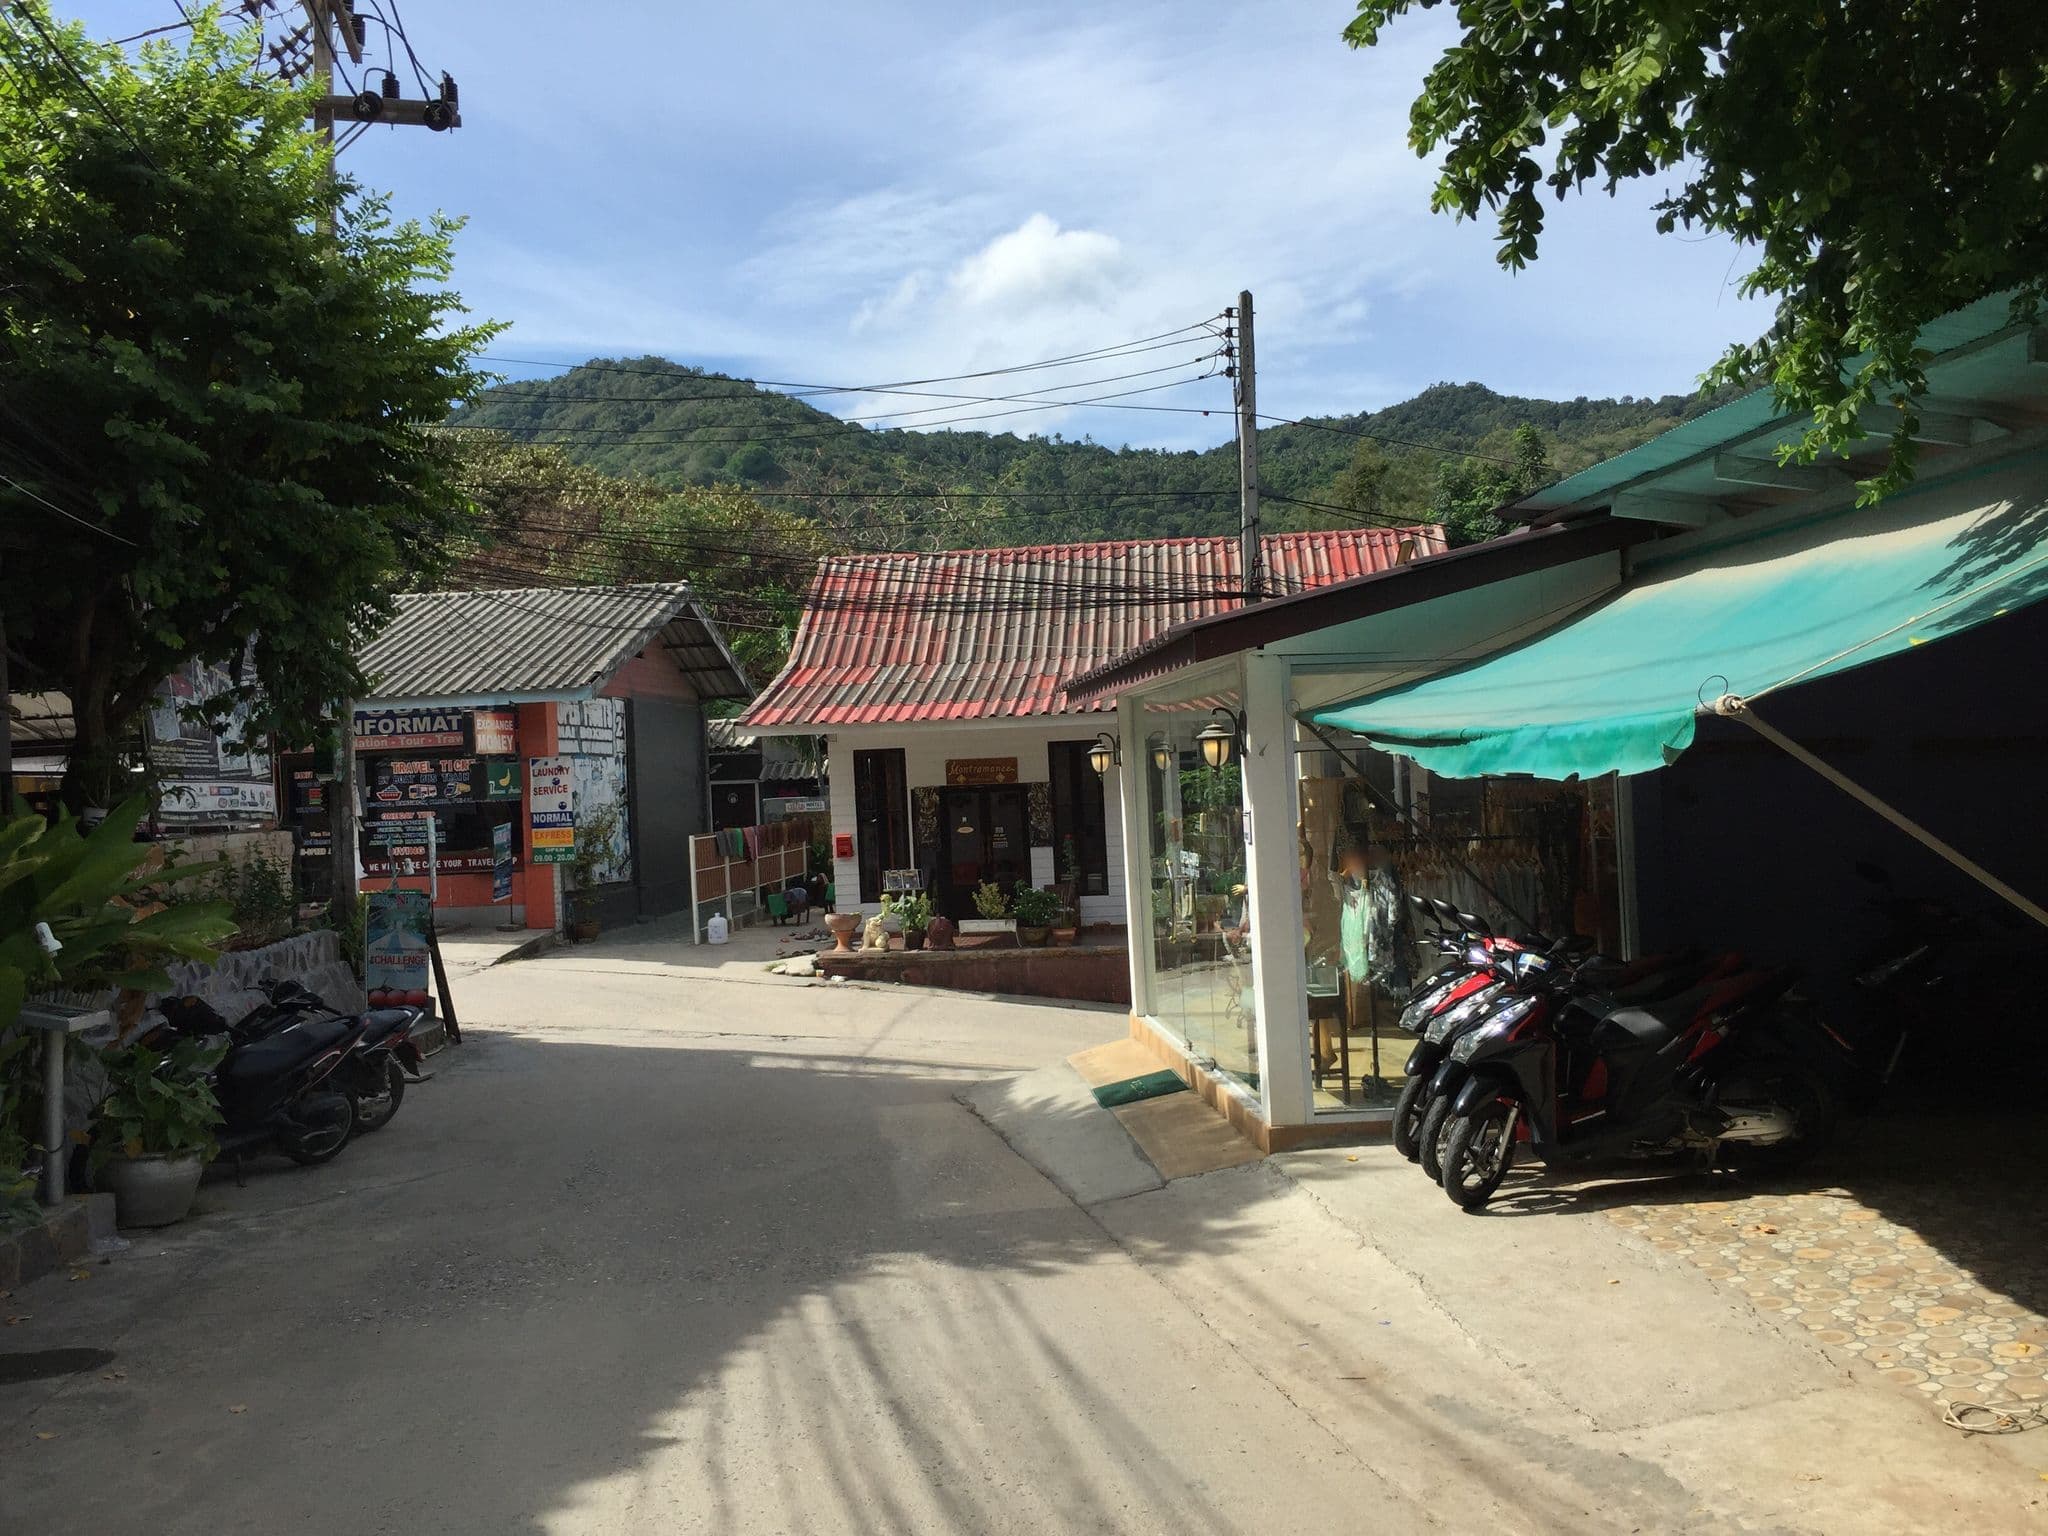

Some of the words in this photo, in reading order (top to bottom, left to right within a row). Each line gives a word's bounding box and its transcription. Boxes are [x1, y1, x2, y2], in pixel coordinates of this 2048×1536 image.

[400, 737, 425, 746] Tour
[475, 734, 514, 751] MONEY
[391, 761, 434, 774] TRAVEL
[532, 767, 570, 777] LAUNDRY
[533, 785, 568, 796] SERVICE
[533, 813, 573, 823] NORMAL
[534, 831, 571, 840] EXPRESS
[369, 862, 380, 871] WE
[443, 858, 463, 868] YOUR
